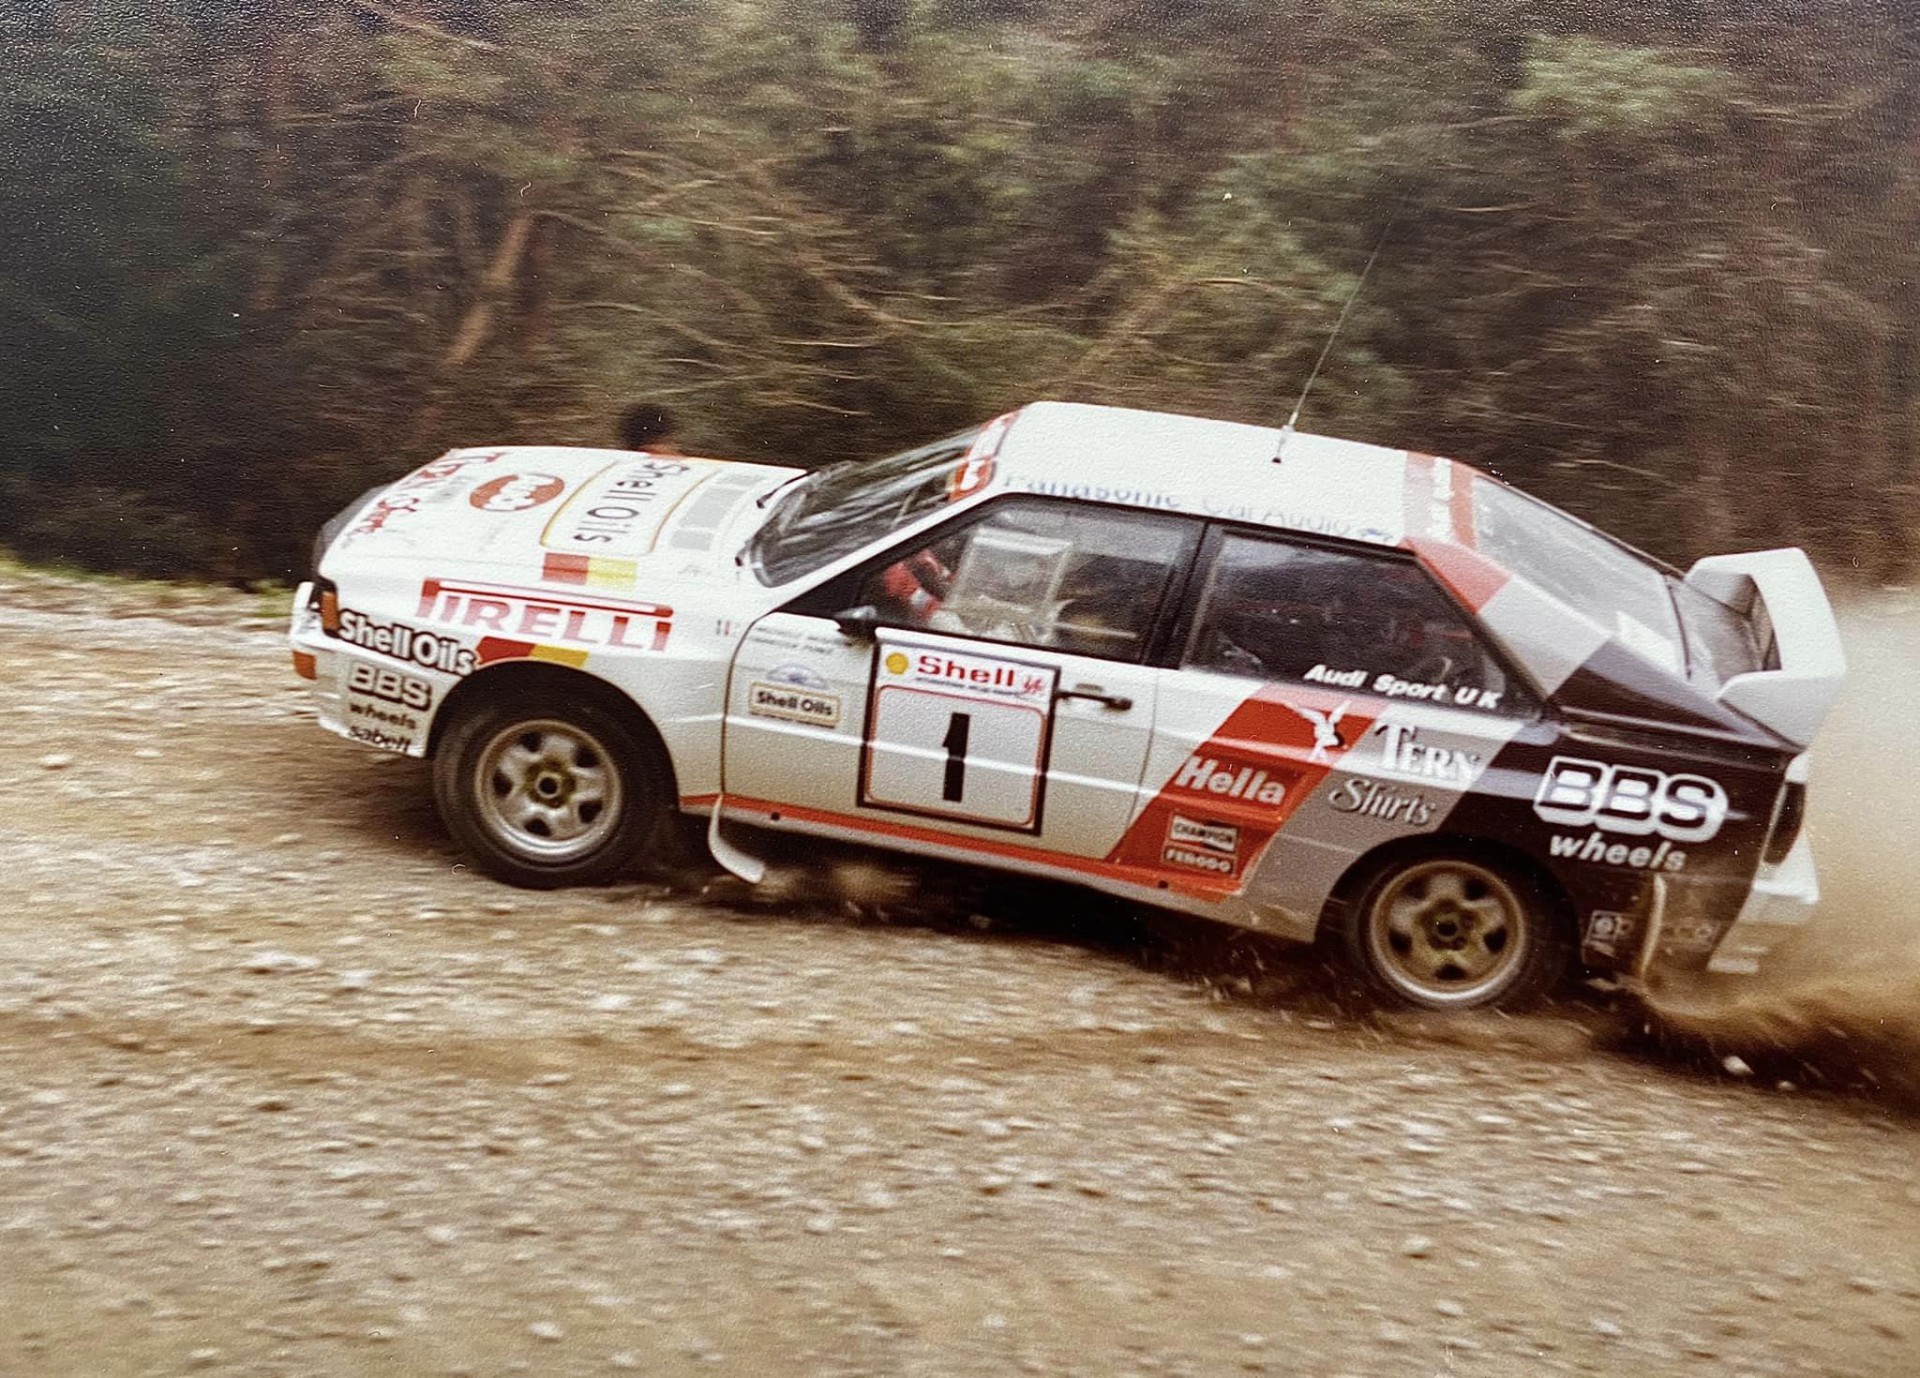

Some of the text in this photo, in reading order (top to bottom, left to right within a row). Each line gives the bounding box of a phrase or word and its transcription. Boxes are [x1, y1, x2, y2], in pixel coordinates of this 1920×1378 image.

[573, 462, 690, 542] Shell Oils
[415, 577, 674, 652] PIRELLI
[340, 608, 414, 661] Shell
[411, 630, 479, 676] Oils
[349, 661, 432, 711] BBS
[917, 655, 1016, 688] Shell
[1303, 663, 1368, 688] Audi
[1373, 674, 1447, 700] Sport
[942, 712, 971, 803] 1
[1174, 756, 1286, 806] Hella
[1327, 777, 1437, 826] Shirts
[1533, 755, 1729, 843] BBS
[1550, 832, 1687, 872] wheels
